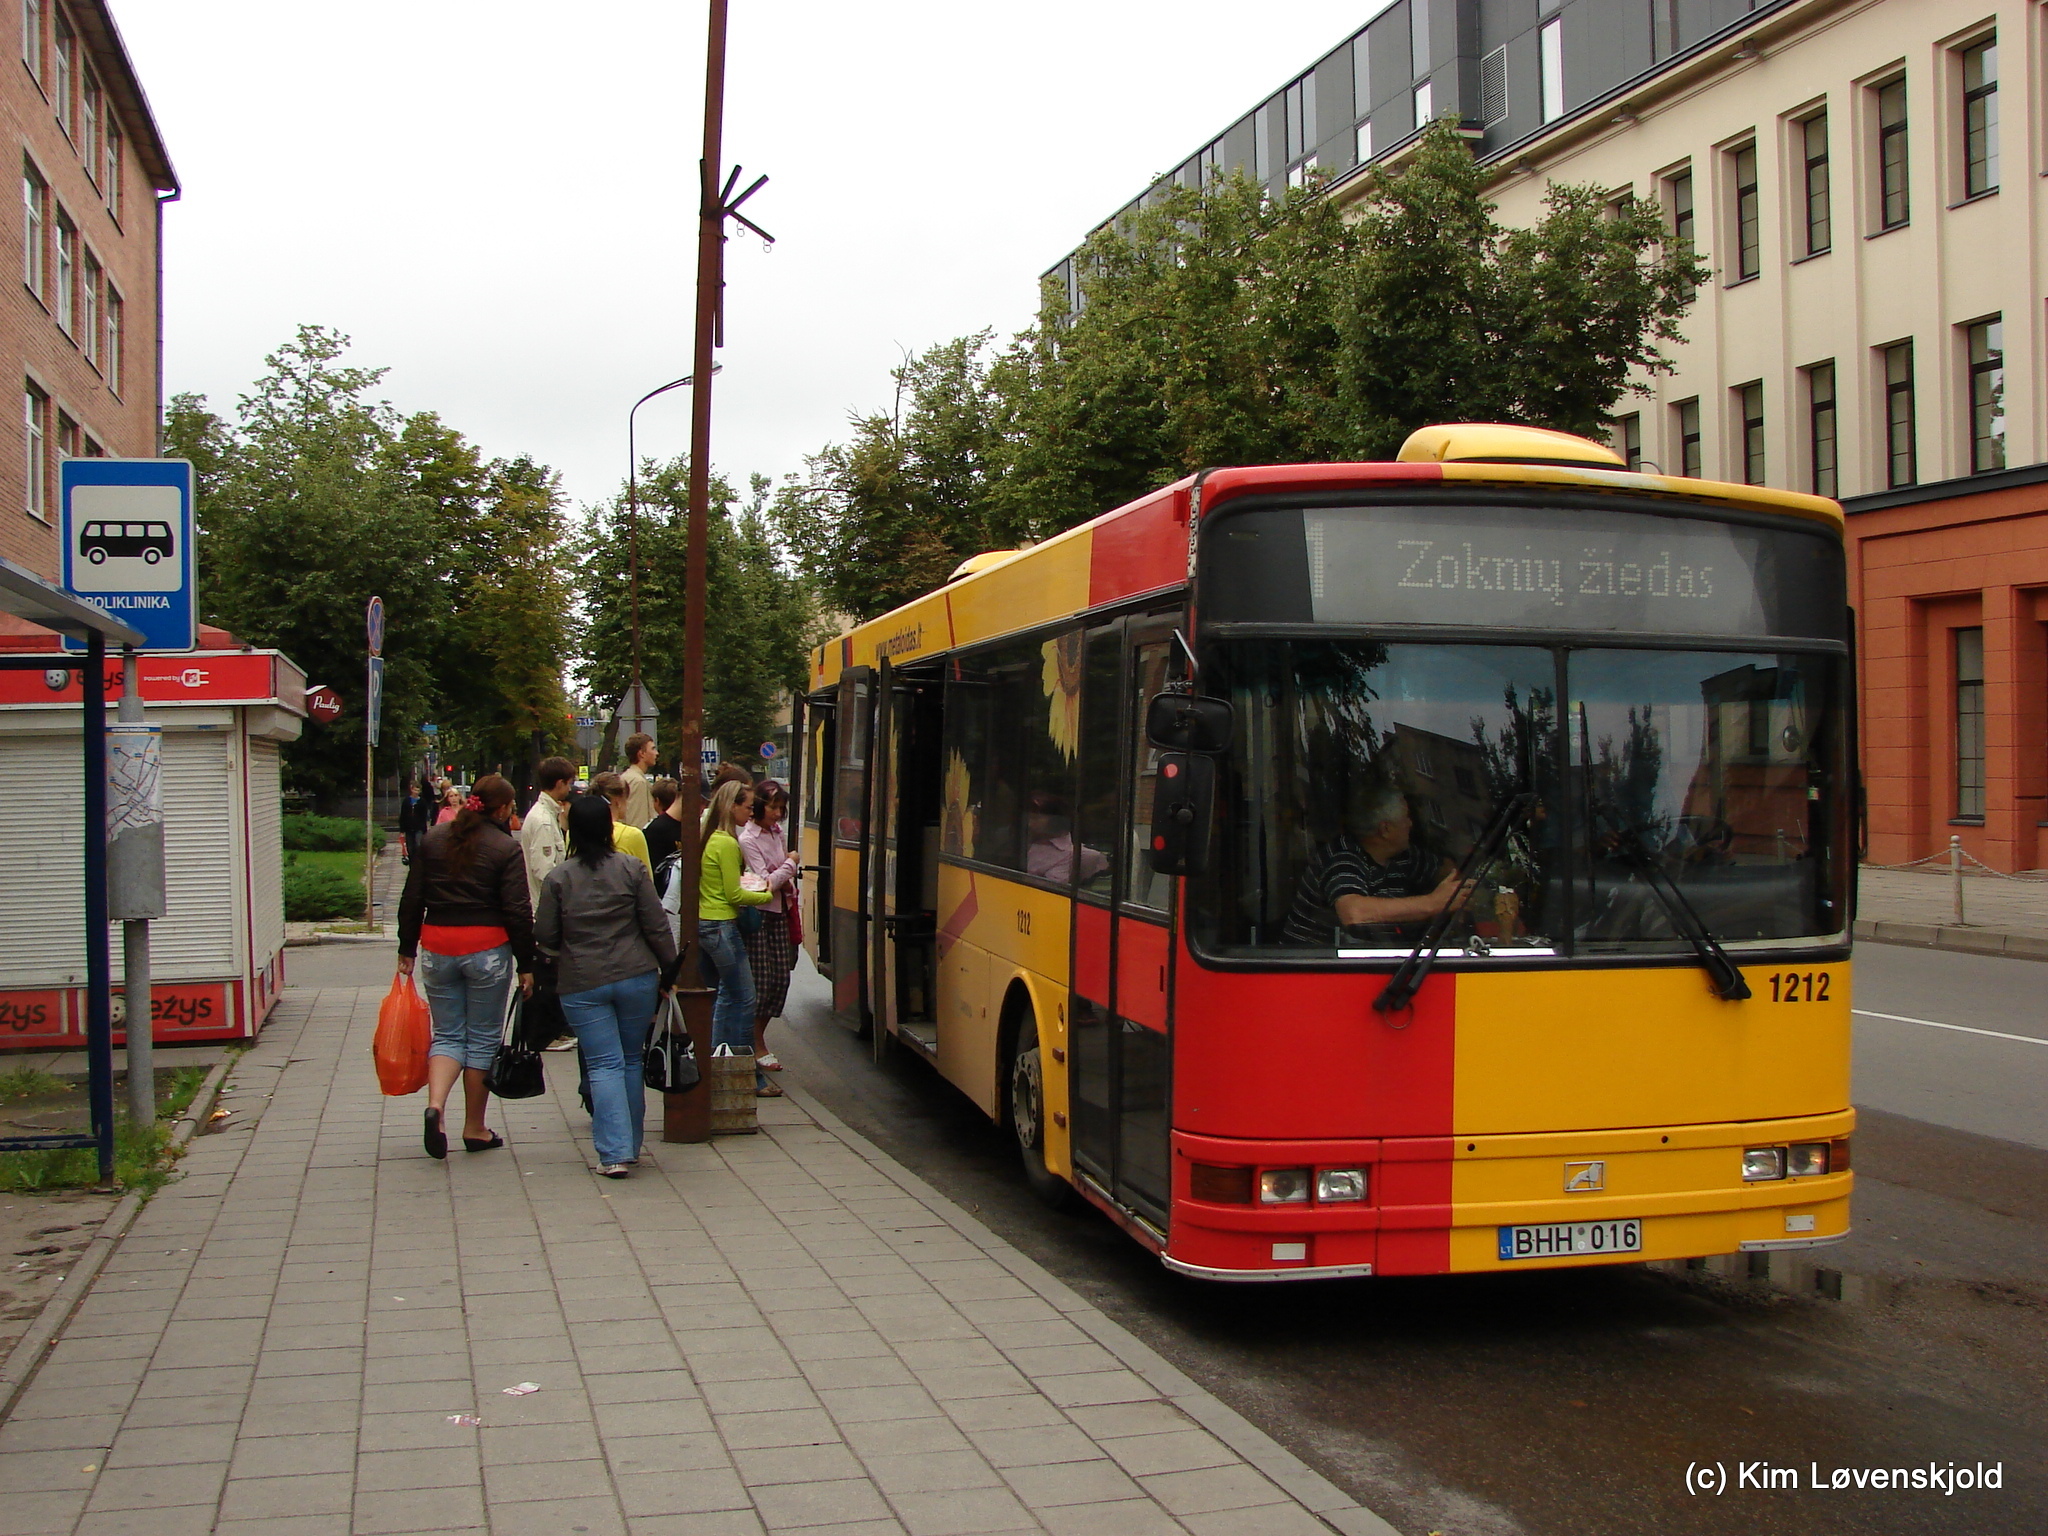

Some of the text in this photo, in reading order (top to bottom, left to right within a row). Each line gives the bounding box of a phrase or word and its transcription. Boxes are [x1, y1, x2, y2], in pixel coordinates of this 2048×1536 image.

[1578, 547, 1713, 599] žiedas
[1017, 908, 1031, 936] 1212
[1768, 972, 1830, 1002] 1212
[1515, 1227, 1573, 1254] BHH
[1590, 1222, 1637, 1250] 016
